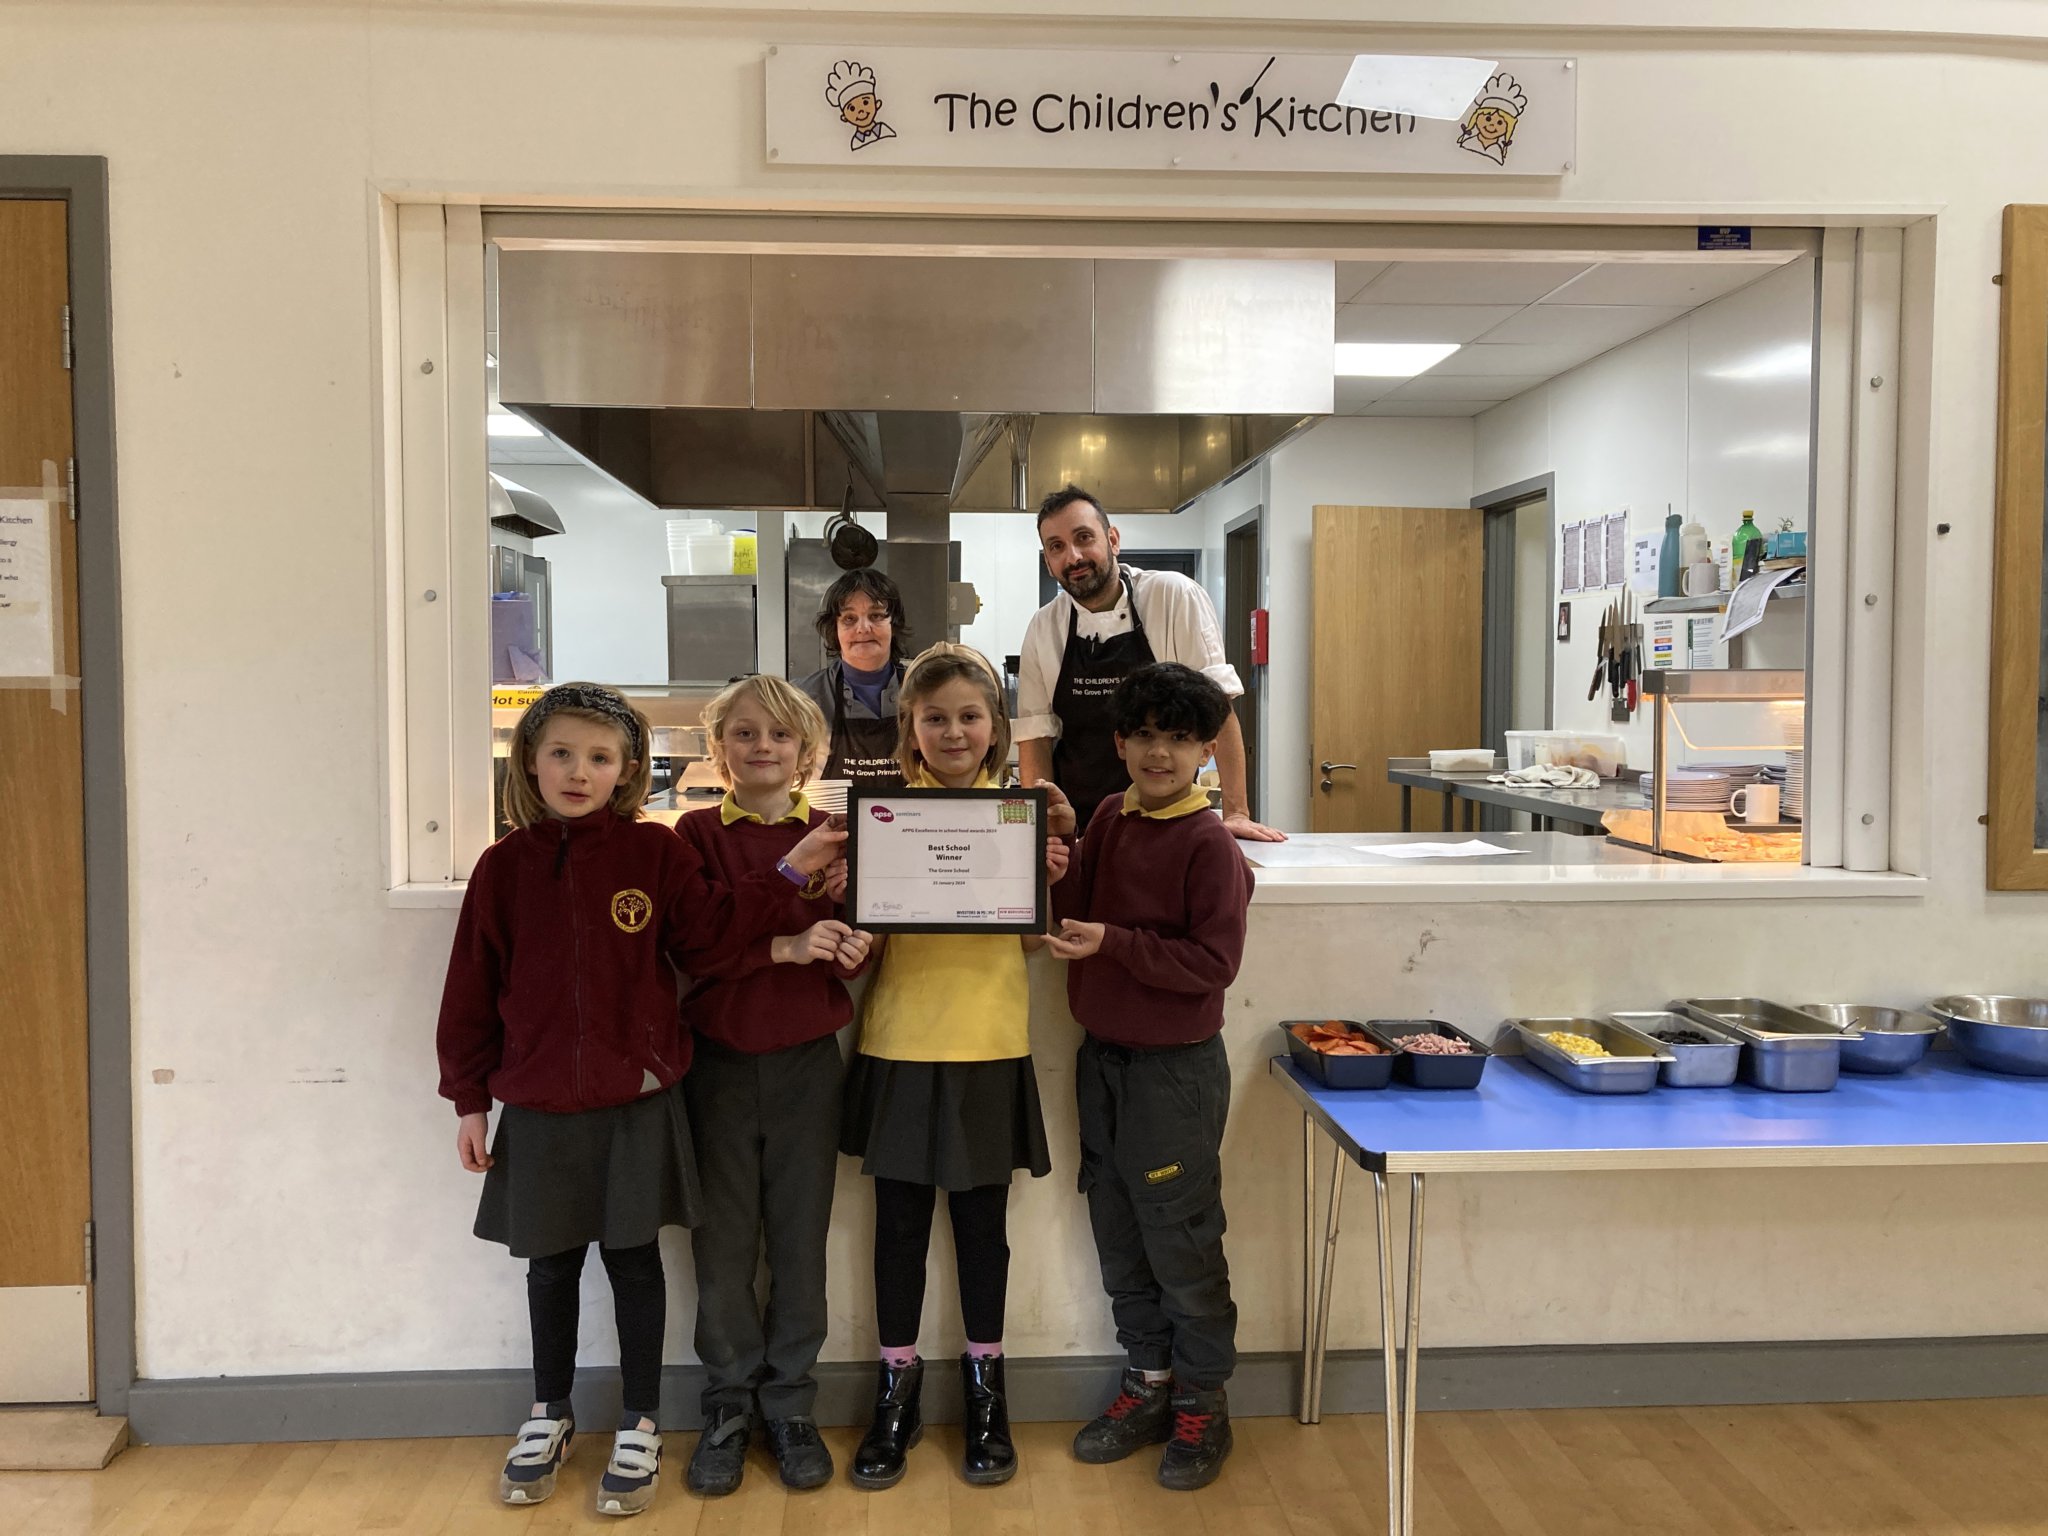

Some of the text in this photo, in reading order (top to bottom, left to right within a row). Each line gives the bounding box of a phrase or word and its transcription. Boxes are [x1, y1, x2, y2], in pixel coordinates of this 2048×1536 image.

[934, 82, 1417, 138] The Children's Kitchen
[1073, 677, 1084, 685] THE
[1085, 677, 1120, 685] CHILDREN'S
[858, 758, 895, 766] CHILDREN'S
[842, 768, 855, 776] The
